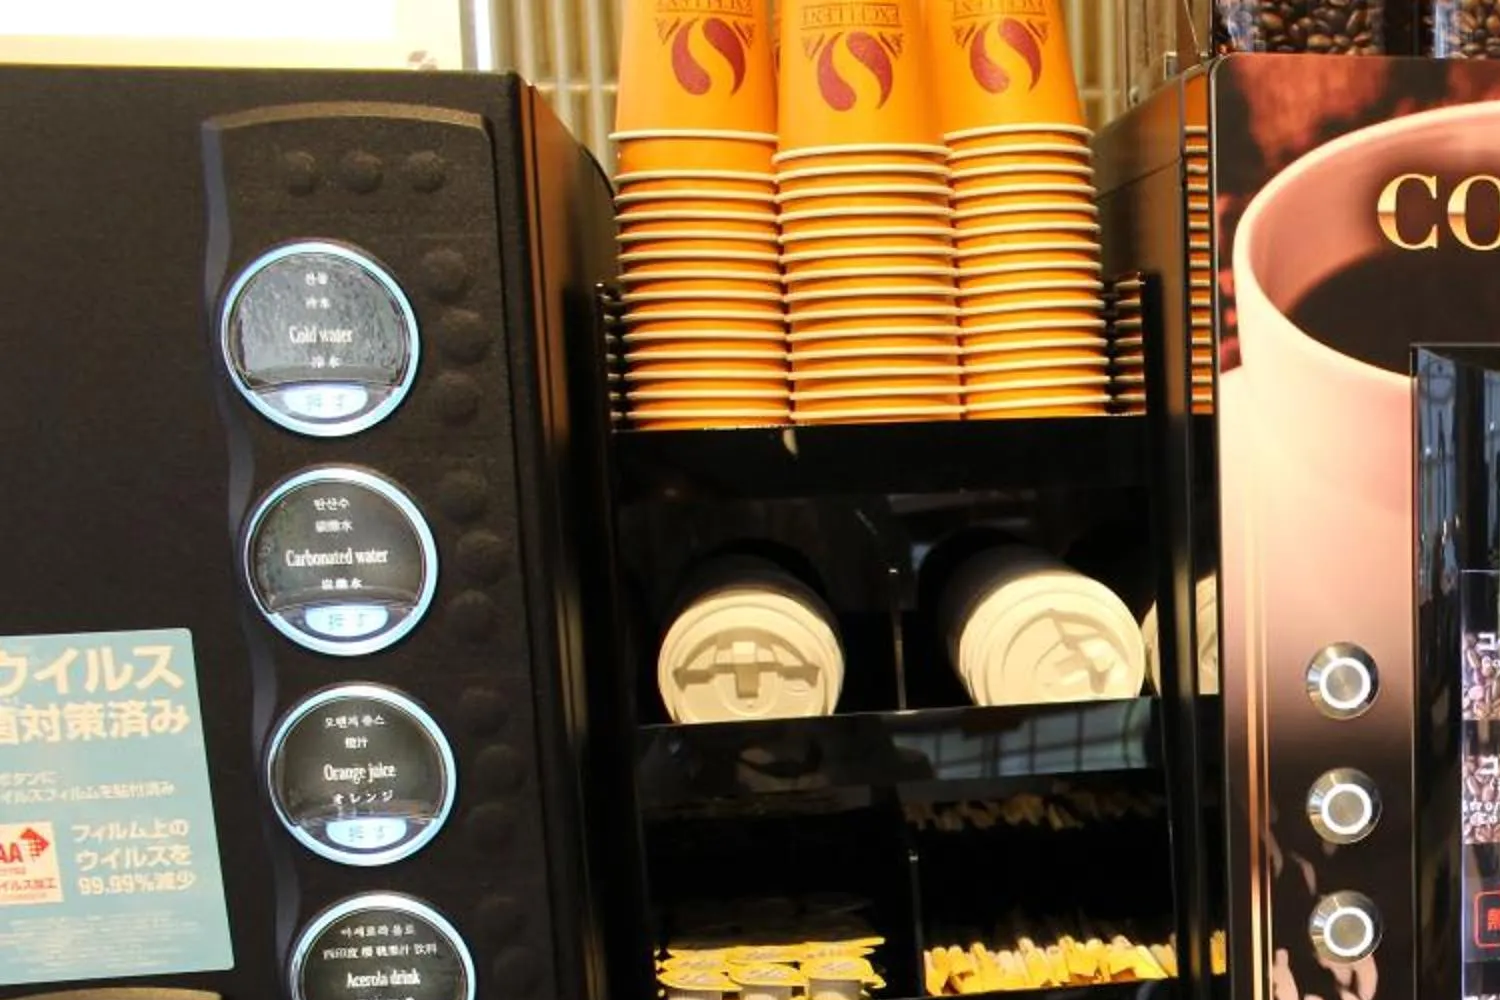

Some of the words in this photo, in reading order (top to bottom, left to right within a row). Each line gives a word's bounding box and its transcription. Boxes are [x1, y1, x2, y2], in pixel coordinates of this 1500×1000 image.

[289, 325, 317, 344] Cold
[319, 327, 352, 343] water
[285, 547, 353, 567] Carbonated
[355, 548, 388, 564] water
[323, 763, 367, 785] Orange
[368, 762, 396, 783] juice
[333, 790, 393, 805] オレンジ
[71, 818, 190, 843] フィルム上の
[76, 845, 192, 872] ウイルスを
[347, 970, 389, 989] Acerola
[390, 967, 421, 986] drink
